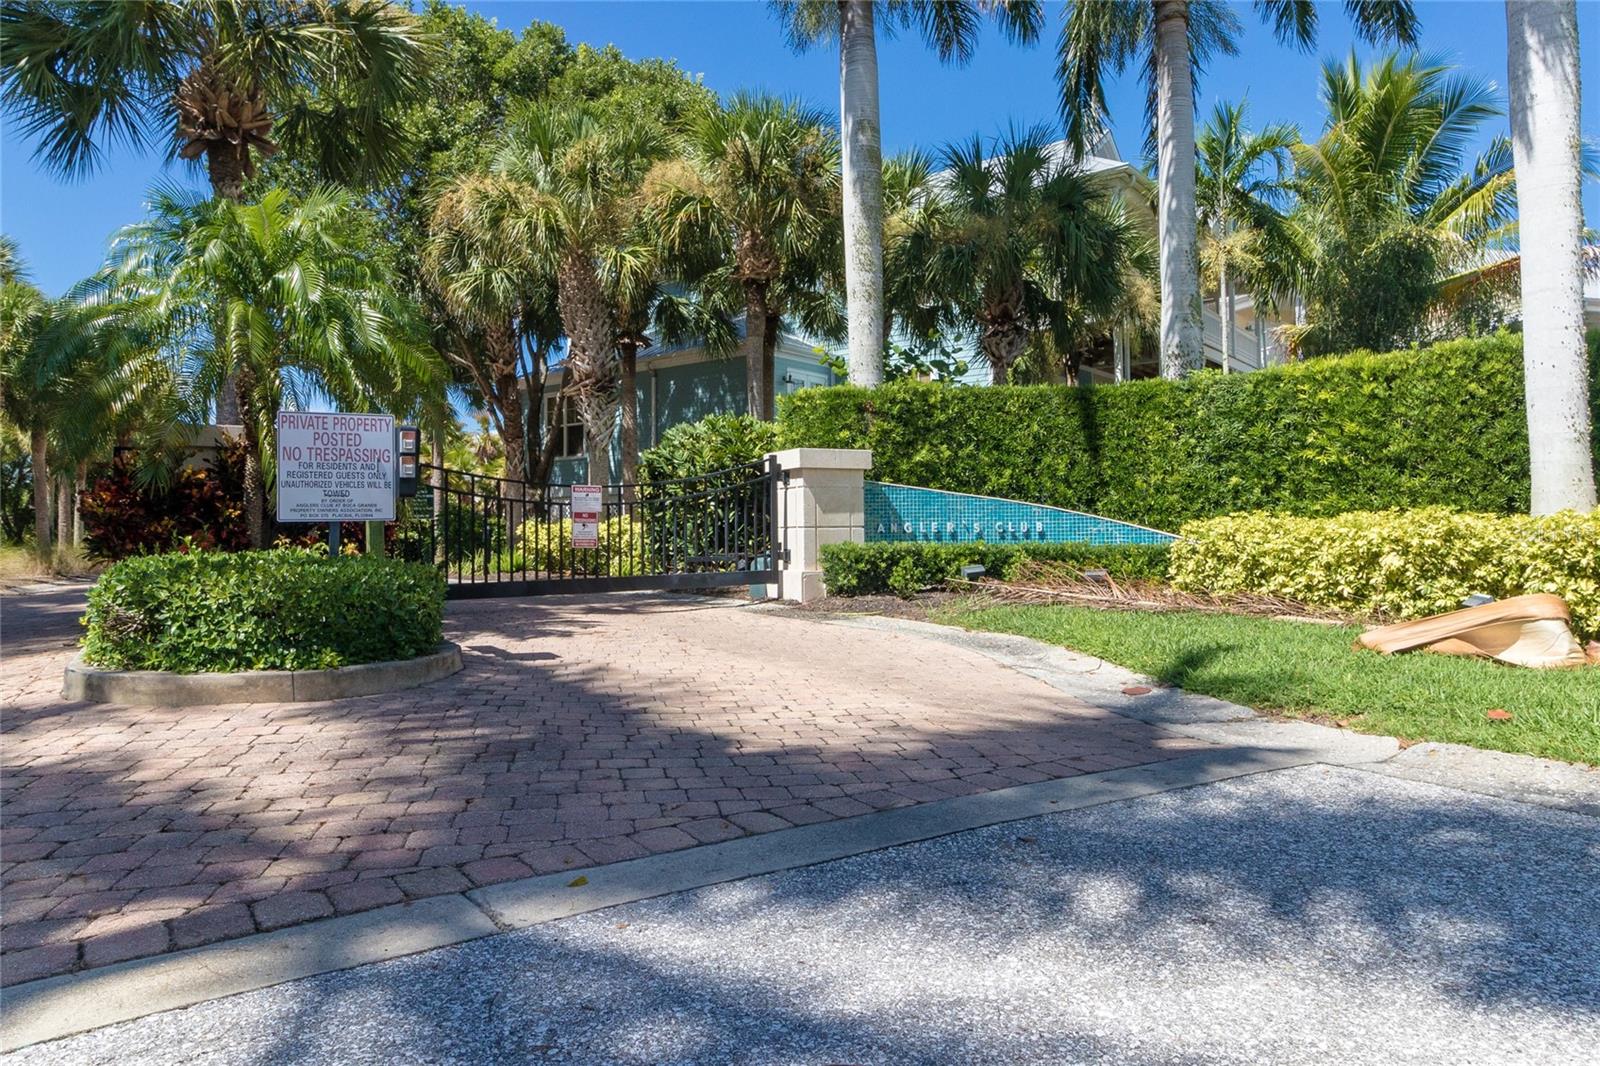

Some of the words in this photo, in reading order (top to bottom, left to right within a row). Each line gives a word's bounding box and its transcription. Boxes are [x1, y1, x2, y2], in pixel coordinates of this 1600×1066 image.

[281, 415, 328, 430] PRIVATE
[333, 417, 391, 432] PROPERTY
[313, 432, 361, 447] POSTED
[282, 447, 301, 461] NO
[307, 447, 390, 463] TRESPASSING
[287, 471, 333, 479] REGISTERED
[996, 522, 1042, 532] CLUB
